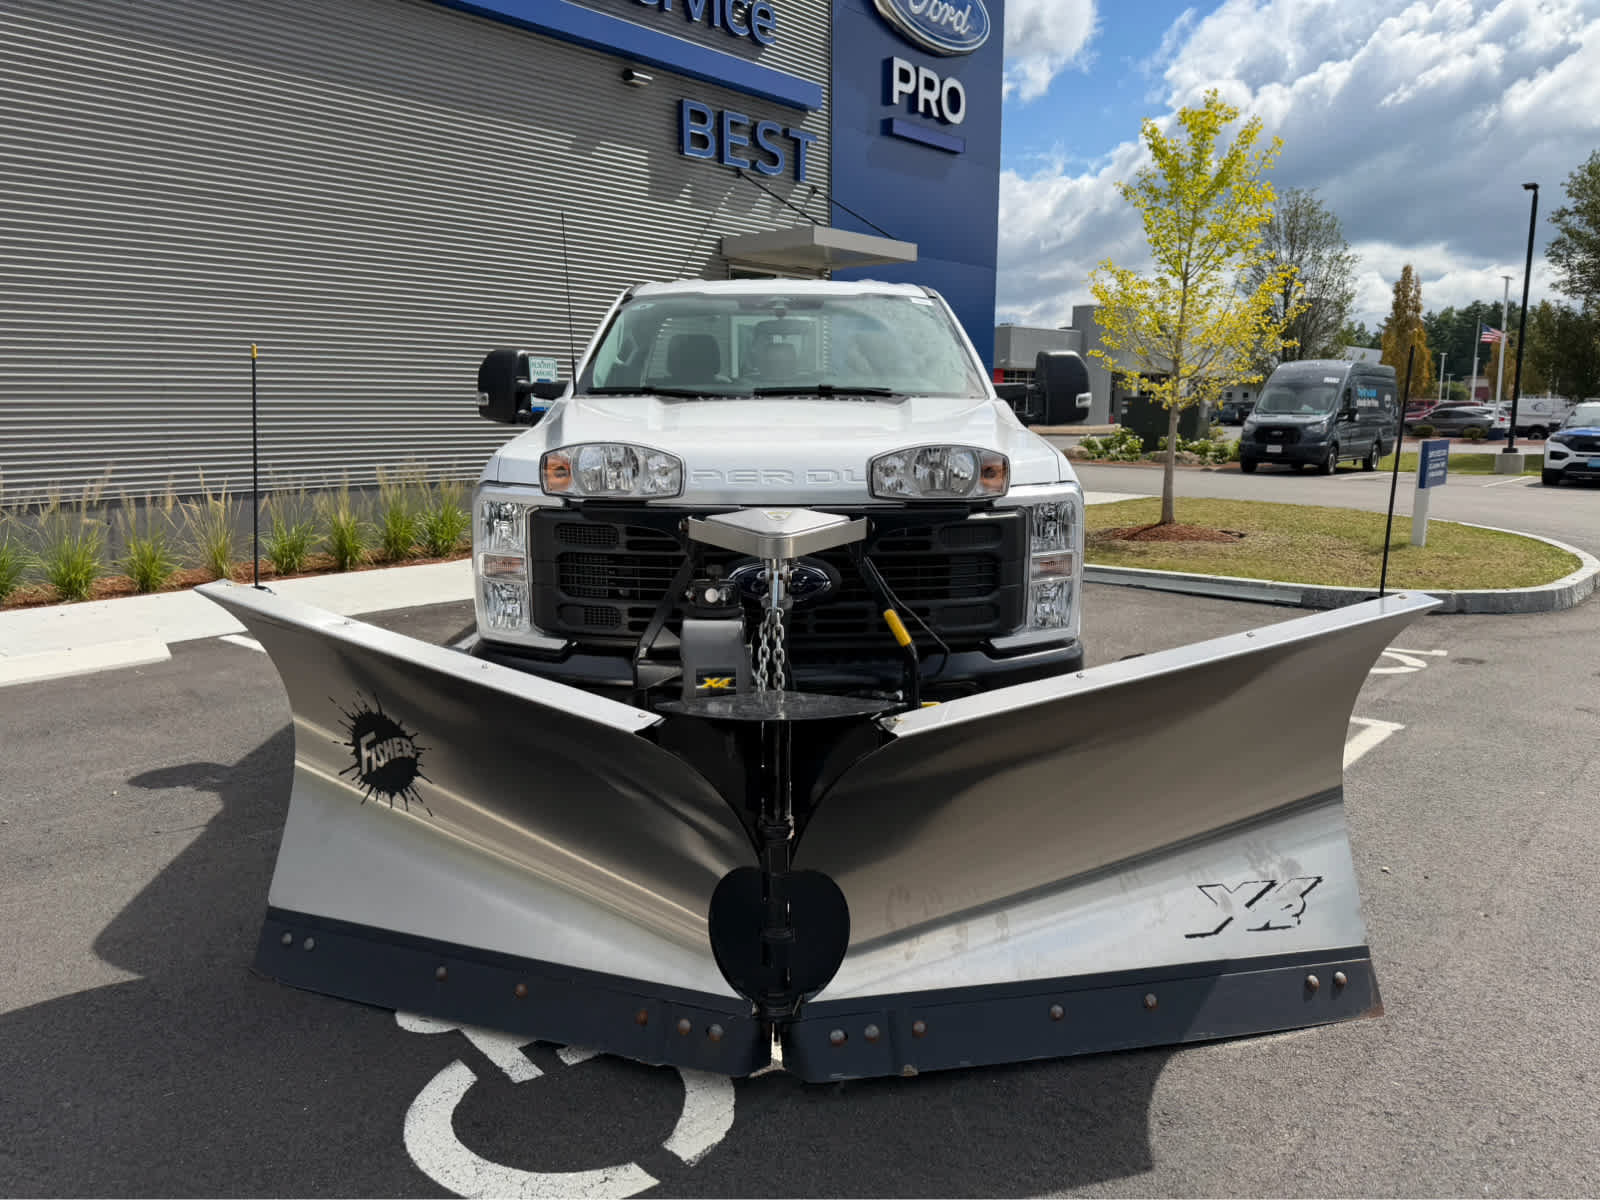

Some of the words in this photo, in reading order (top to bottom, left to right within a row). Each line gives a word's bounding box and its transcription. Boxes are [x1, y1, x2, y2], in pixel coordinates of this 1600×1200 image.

[892, 56, 966, 124] PRO
[682, 99, 817, 183] BEST
[689, 468, 793, 486] PER
[360, 731, 417, 776] FISHER
